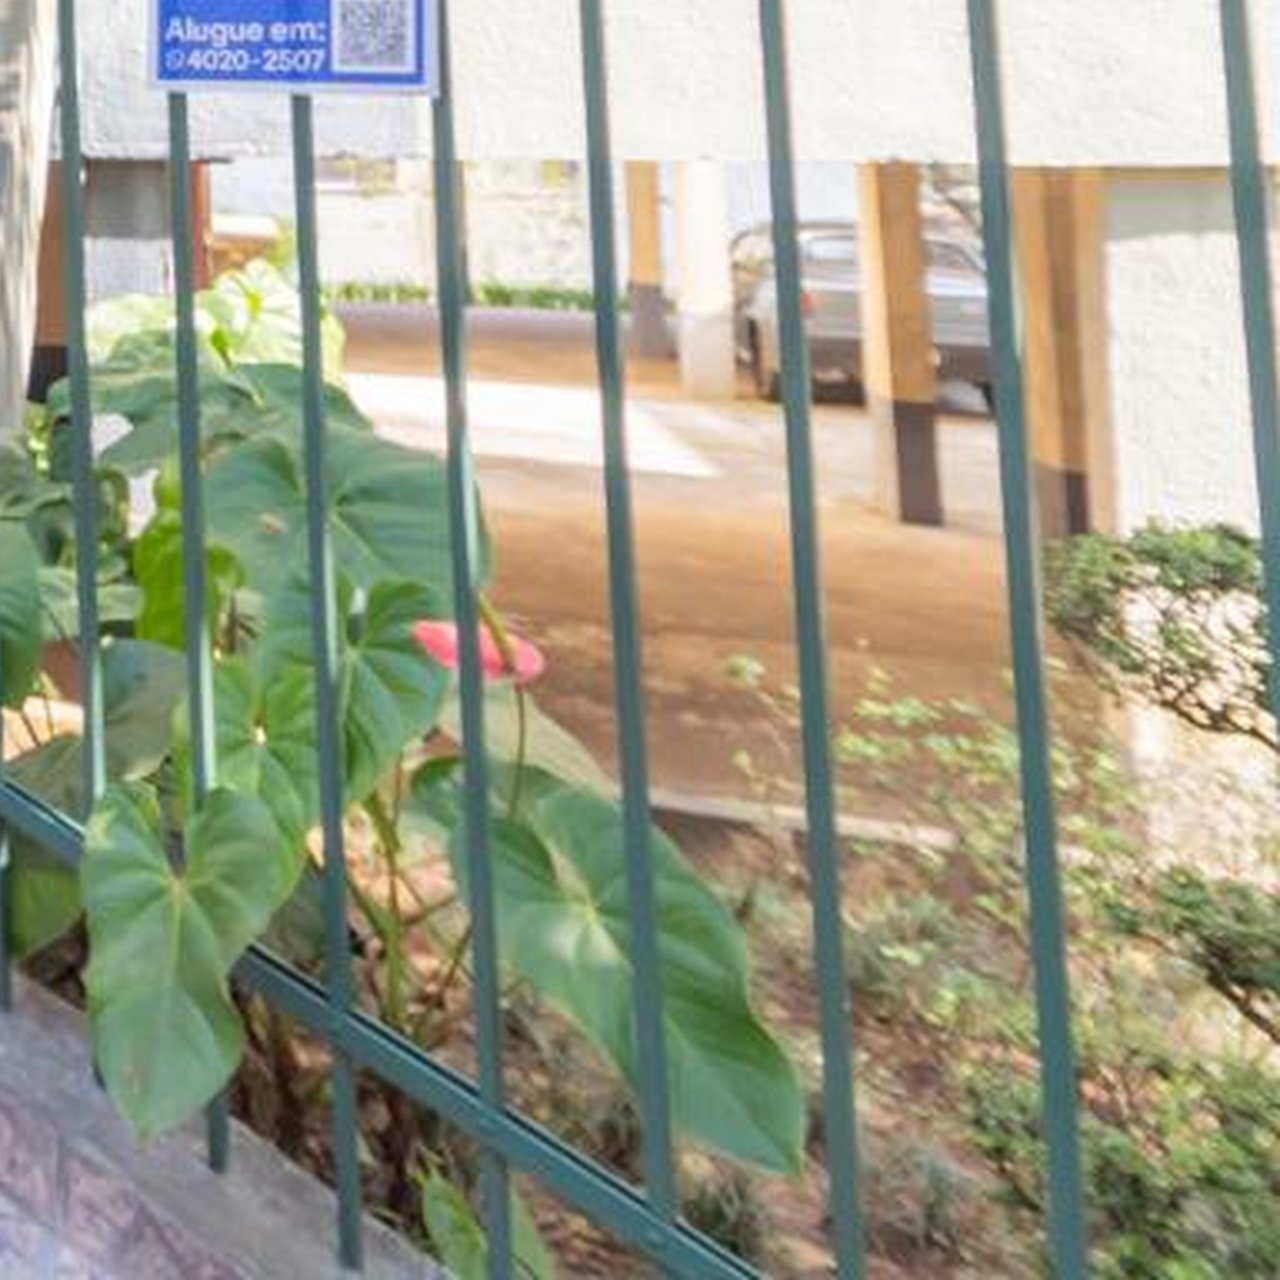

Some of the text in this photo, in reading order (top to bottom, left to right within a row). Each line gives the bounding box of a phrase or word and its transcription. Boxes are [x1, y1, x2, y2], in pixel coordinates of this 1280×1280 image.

[165, 17, 326, 47] Alugue em:
[186, 49, 326, 72] 4020-2507
